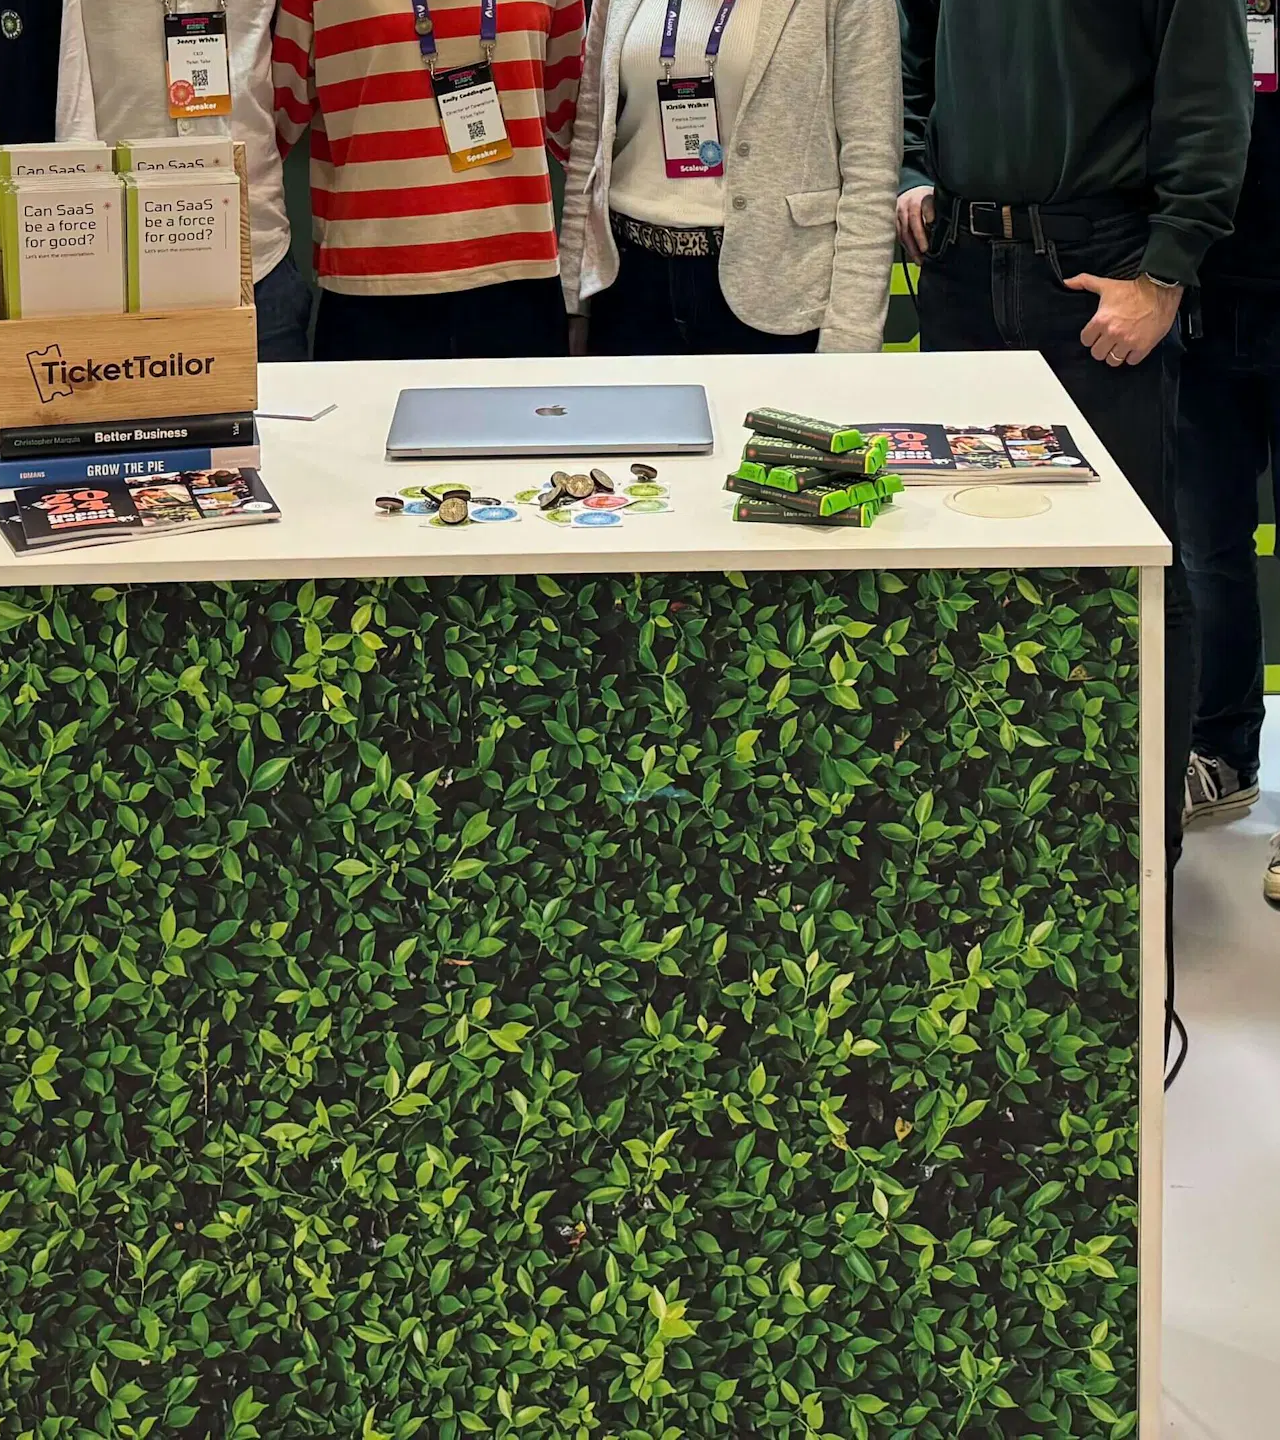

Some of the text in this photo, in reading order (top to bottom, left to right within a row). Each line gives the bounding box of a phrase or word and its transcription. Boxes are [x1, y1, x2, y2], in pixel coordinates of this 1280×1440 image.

[24, 203, 94, 217] Can SaaS
[144, 199, 213, 213] Can SaaS
[25, 220, 96, 233] be a force
[145, 215, 215, 228] be a force
[25, 234, 95, 250] for good?
[145, 229, 213, 244] for good?
[42, 353, 215, 385] TicketTailor
[94, 429, 132, 443] Better
[133, 427, 189, 441] Business
[87, 460, 165, 477] GROW THE PIE
[40, 490, 110, 505] 20
